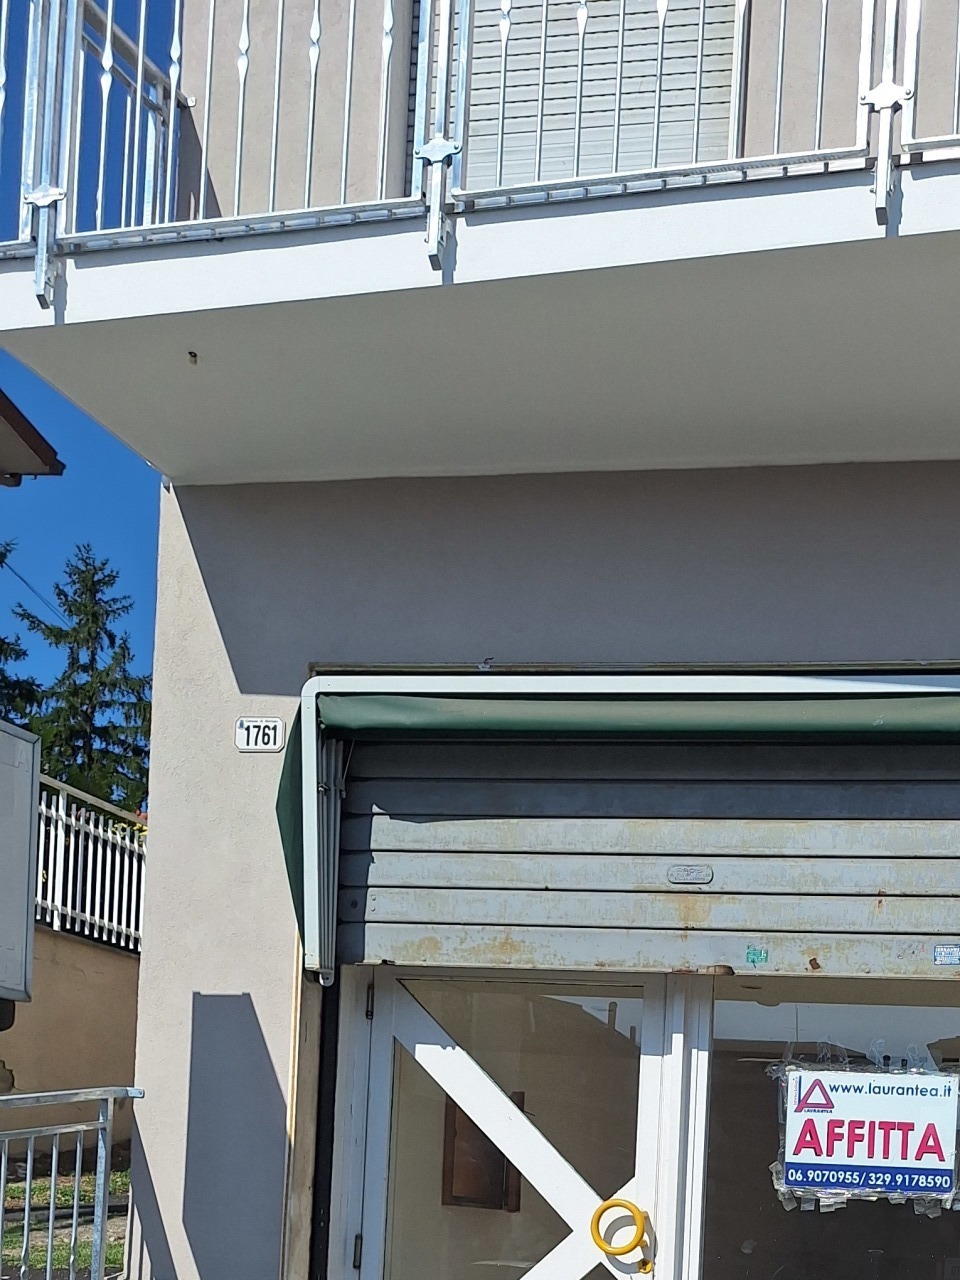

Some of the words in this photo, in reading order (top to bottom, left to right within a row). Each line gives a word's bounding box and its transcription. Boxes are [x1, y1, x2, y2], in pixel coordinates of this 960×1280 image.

[244, 724, 277, 746] 1761
[828, 1082, 952, 1098] www.laurantea.it
[793, 1118, 946, 1162] AFFITTA
